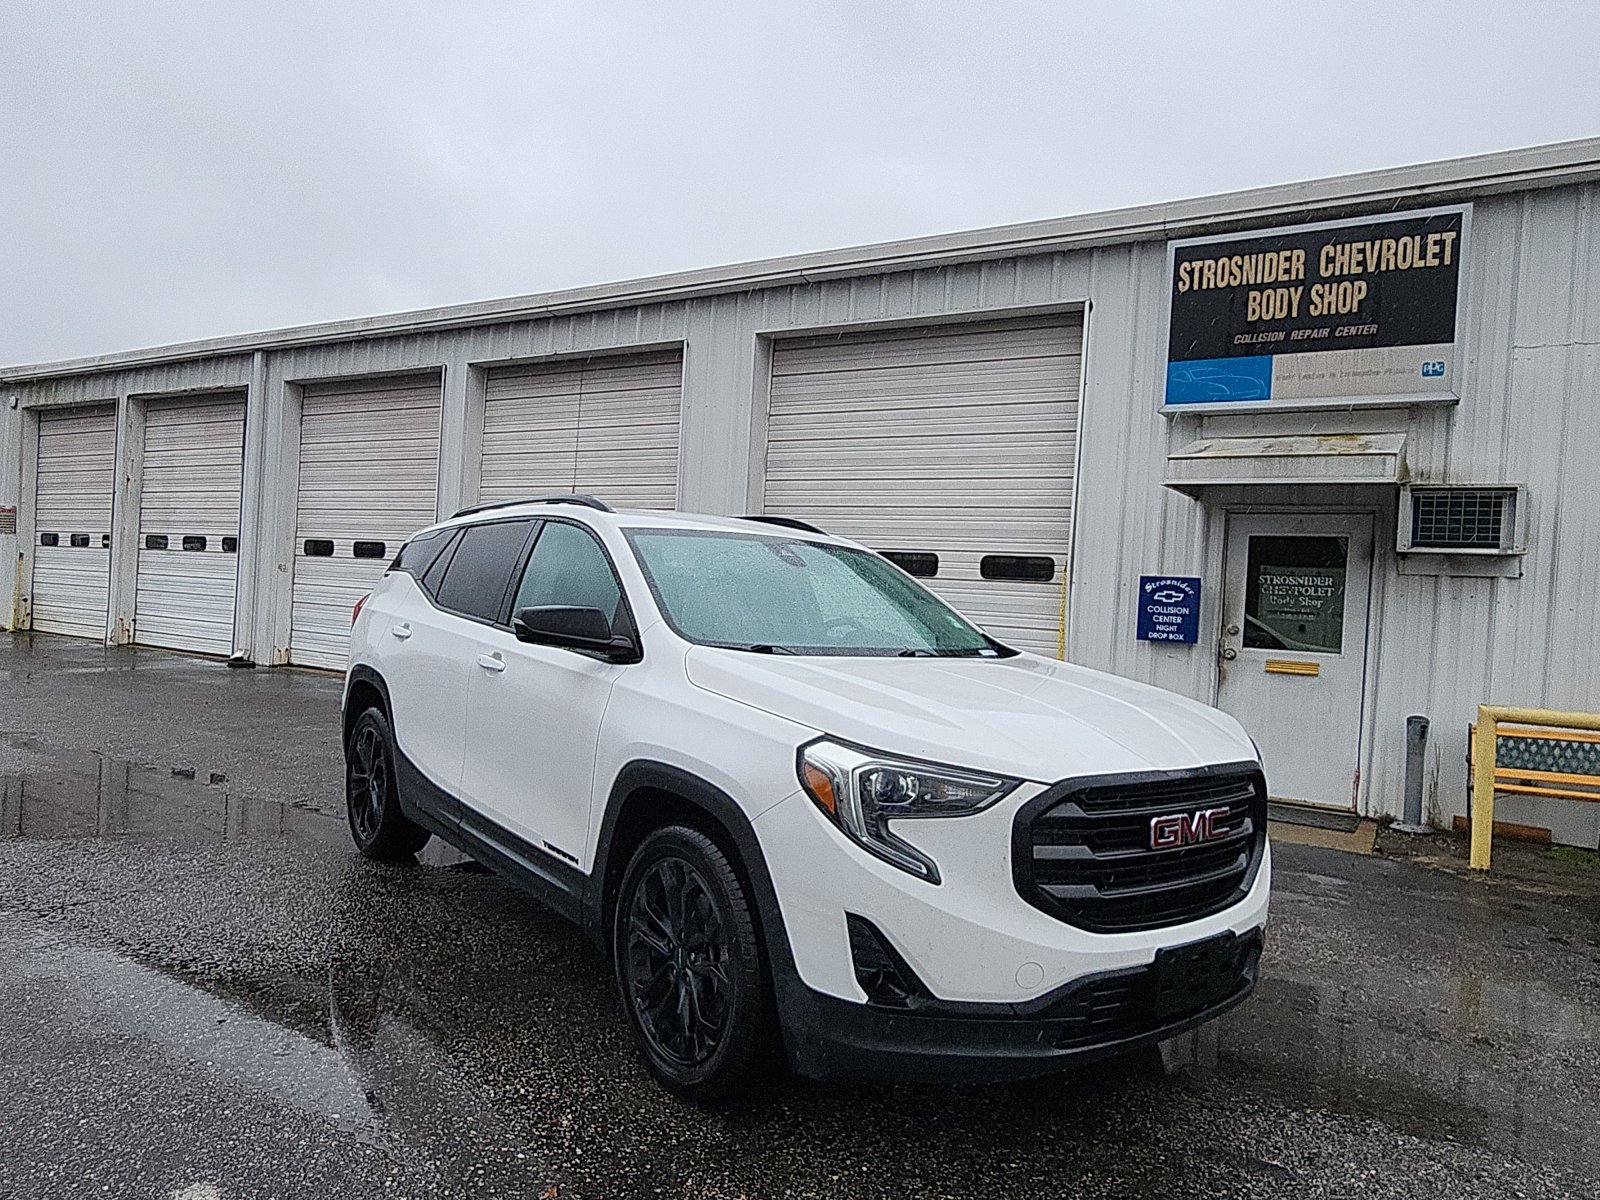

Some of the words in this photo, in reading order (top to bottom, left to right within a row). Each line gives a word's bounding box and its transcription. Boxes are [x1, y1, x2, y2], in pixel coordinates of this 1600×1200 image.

[1178, 249, 1306, 293] STROSNIDER
[1319, 231, 1457, 277] CHEVROLET
[1247, 286, 1304, 322] BODY
[1310, 281, 1368, 317] SHOP
[1233, 331, 1286, 345] COLLISION
[1290, 327, 1331, 341] REPAIR
[1334, 324, 1379, 338] CENTER
[1423, 361, 1444, 375] PPG
[1145, 579, 1195, 595] Strosnider
[1258, 575, 1333, 586] STROSNIDER
[1147, 605, 1190, 615] COLLISION
[1152, 615, 1183, 624] CENTER
[1155, 624, 1178, 632] NIGHT
[1148, 631, 1168, 639] DROP
[1168, 633, 1185, 641] BOX
[1150, 806, 1231, 849] GMC
